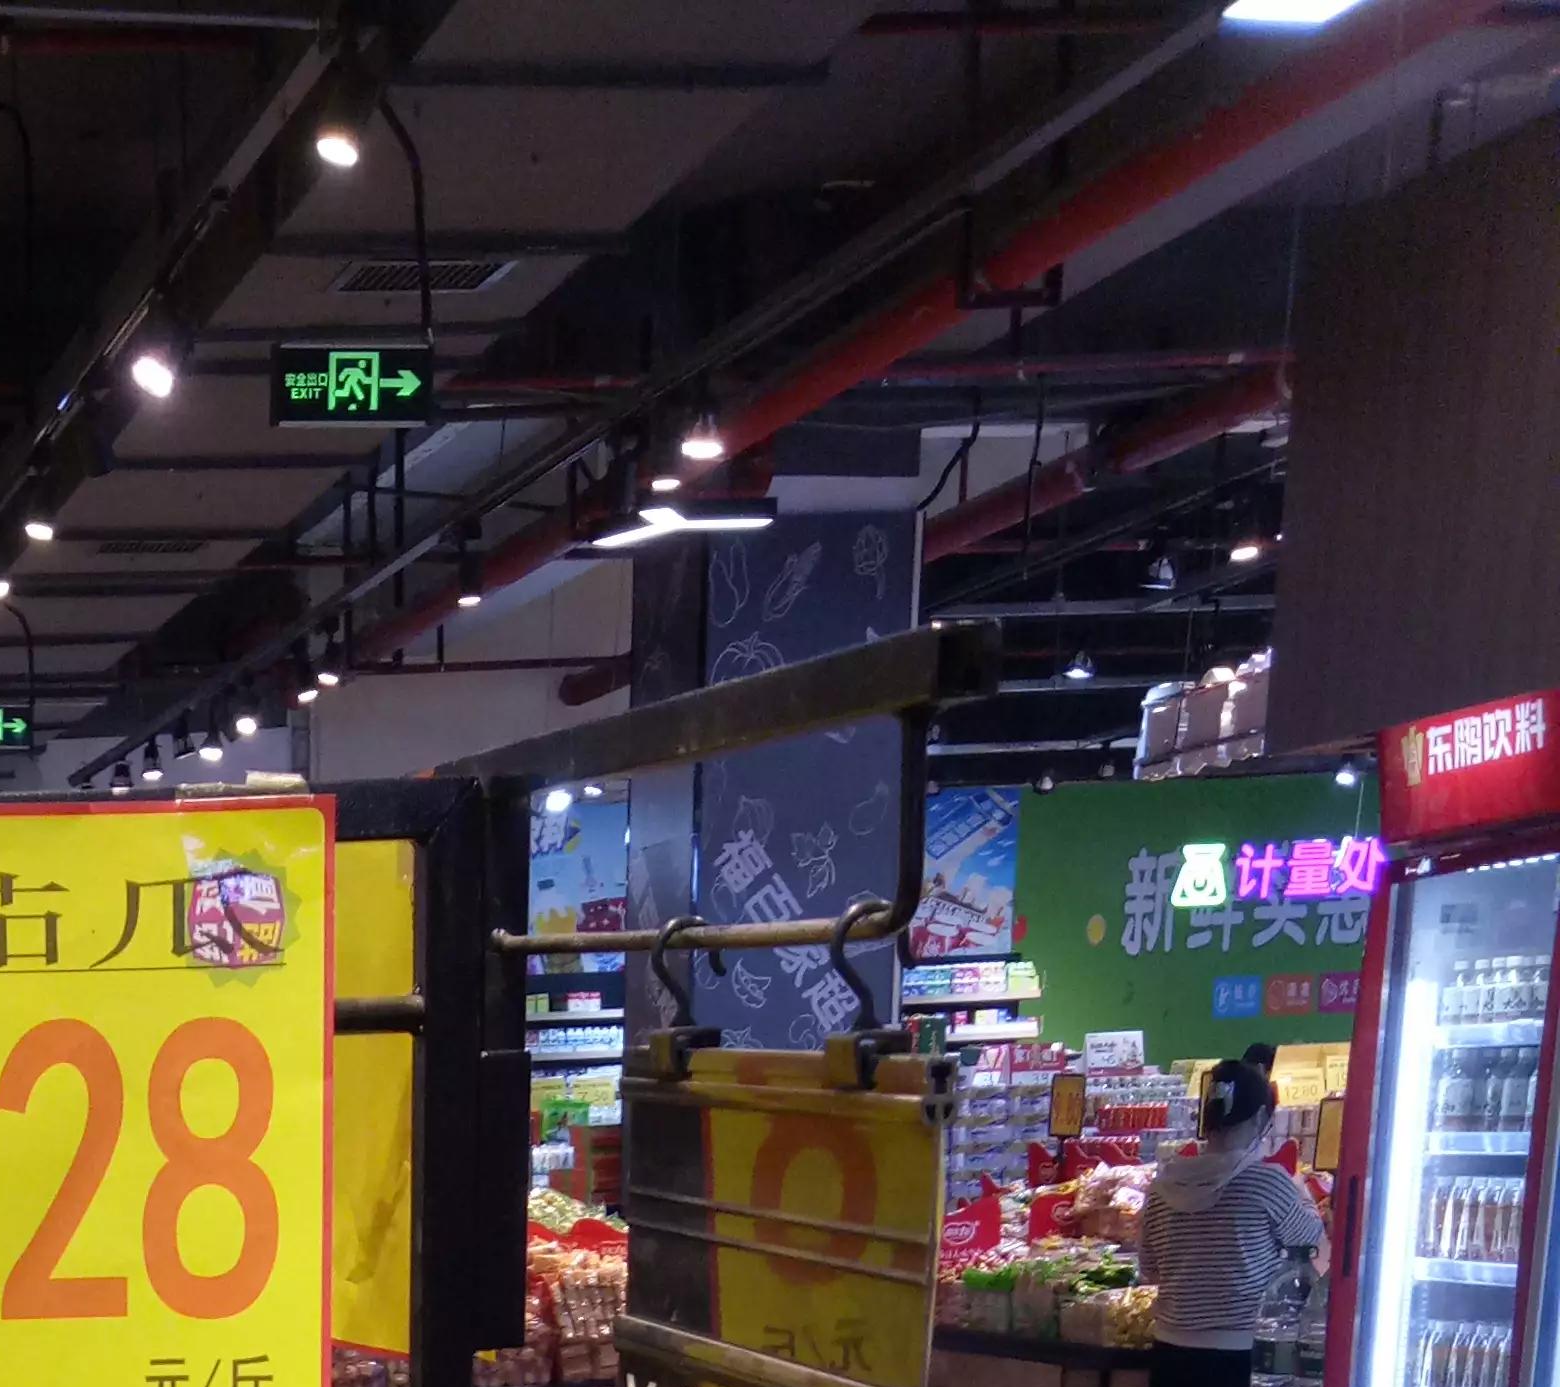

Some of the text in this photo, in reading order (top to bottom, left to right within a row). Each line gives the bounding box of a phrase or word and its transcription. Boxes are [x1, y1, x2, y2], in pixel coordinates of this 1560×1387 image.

[291, 387, 323, 399] EXIT
[1426, 698, 1546, 775] 东鹏饮料
[1236, 837, 1385, 899] 计量处
